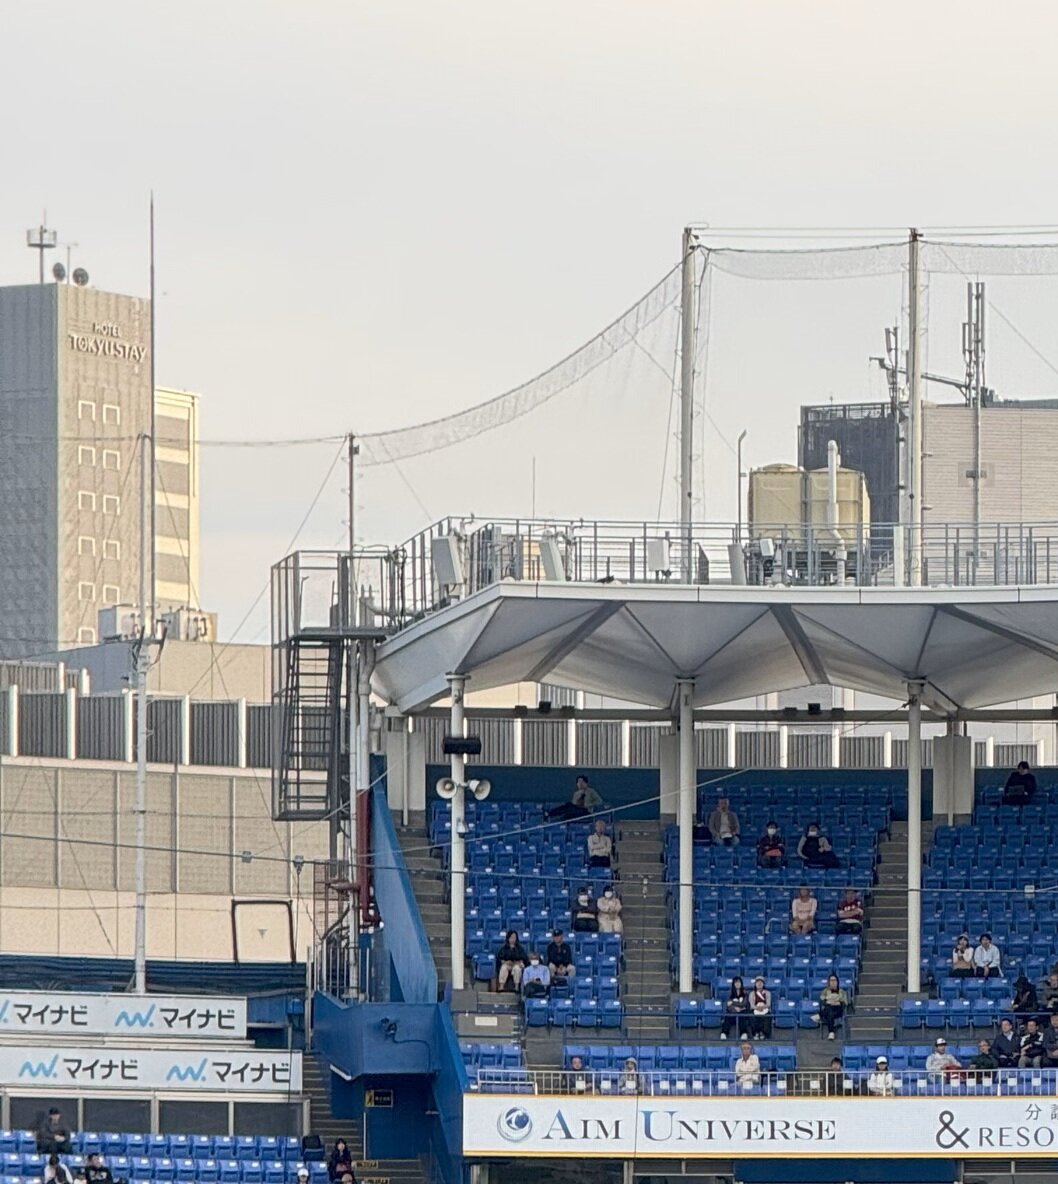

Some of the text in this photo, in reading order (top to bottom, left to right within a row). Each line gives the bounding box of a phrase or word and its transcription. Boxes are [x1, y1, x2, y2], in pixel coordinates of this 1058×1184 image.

[92, 322, 121, 338] HOTEL
[13, 1004, 235, 1030] マイナビ マイナビ
[63, 1058, 290, 1083] マイナビ マイナビ
[541, 1109, 836, 1142] AIM UNIVERSE
[935, 1110, 970, 1150] &
